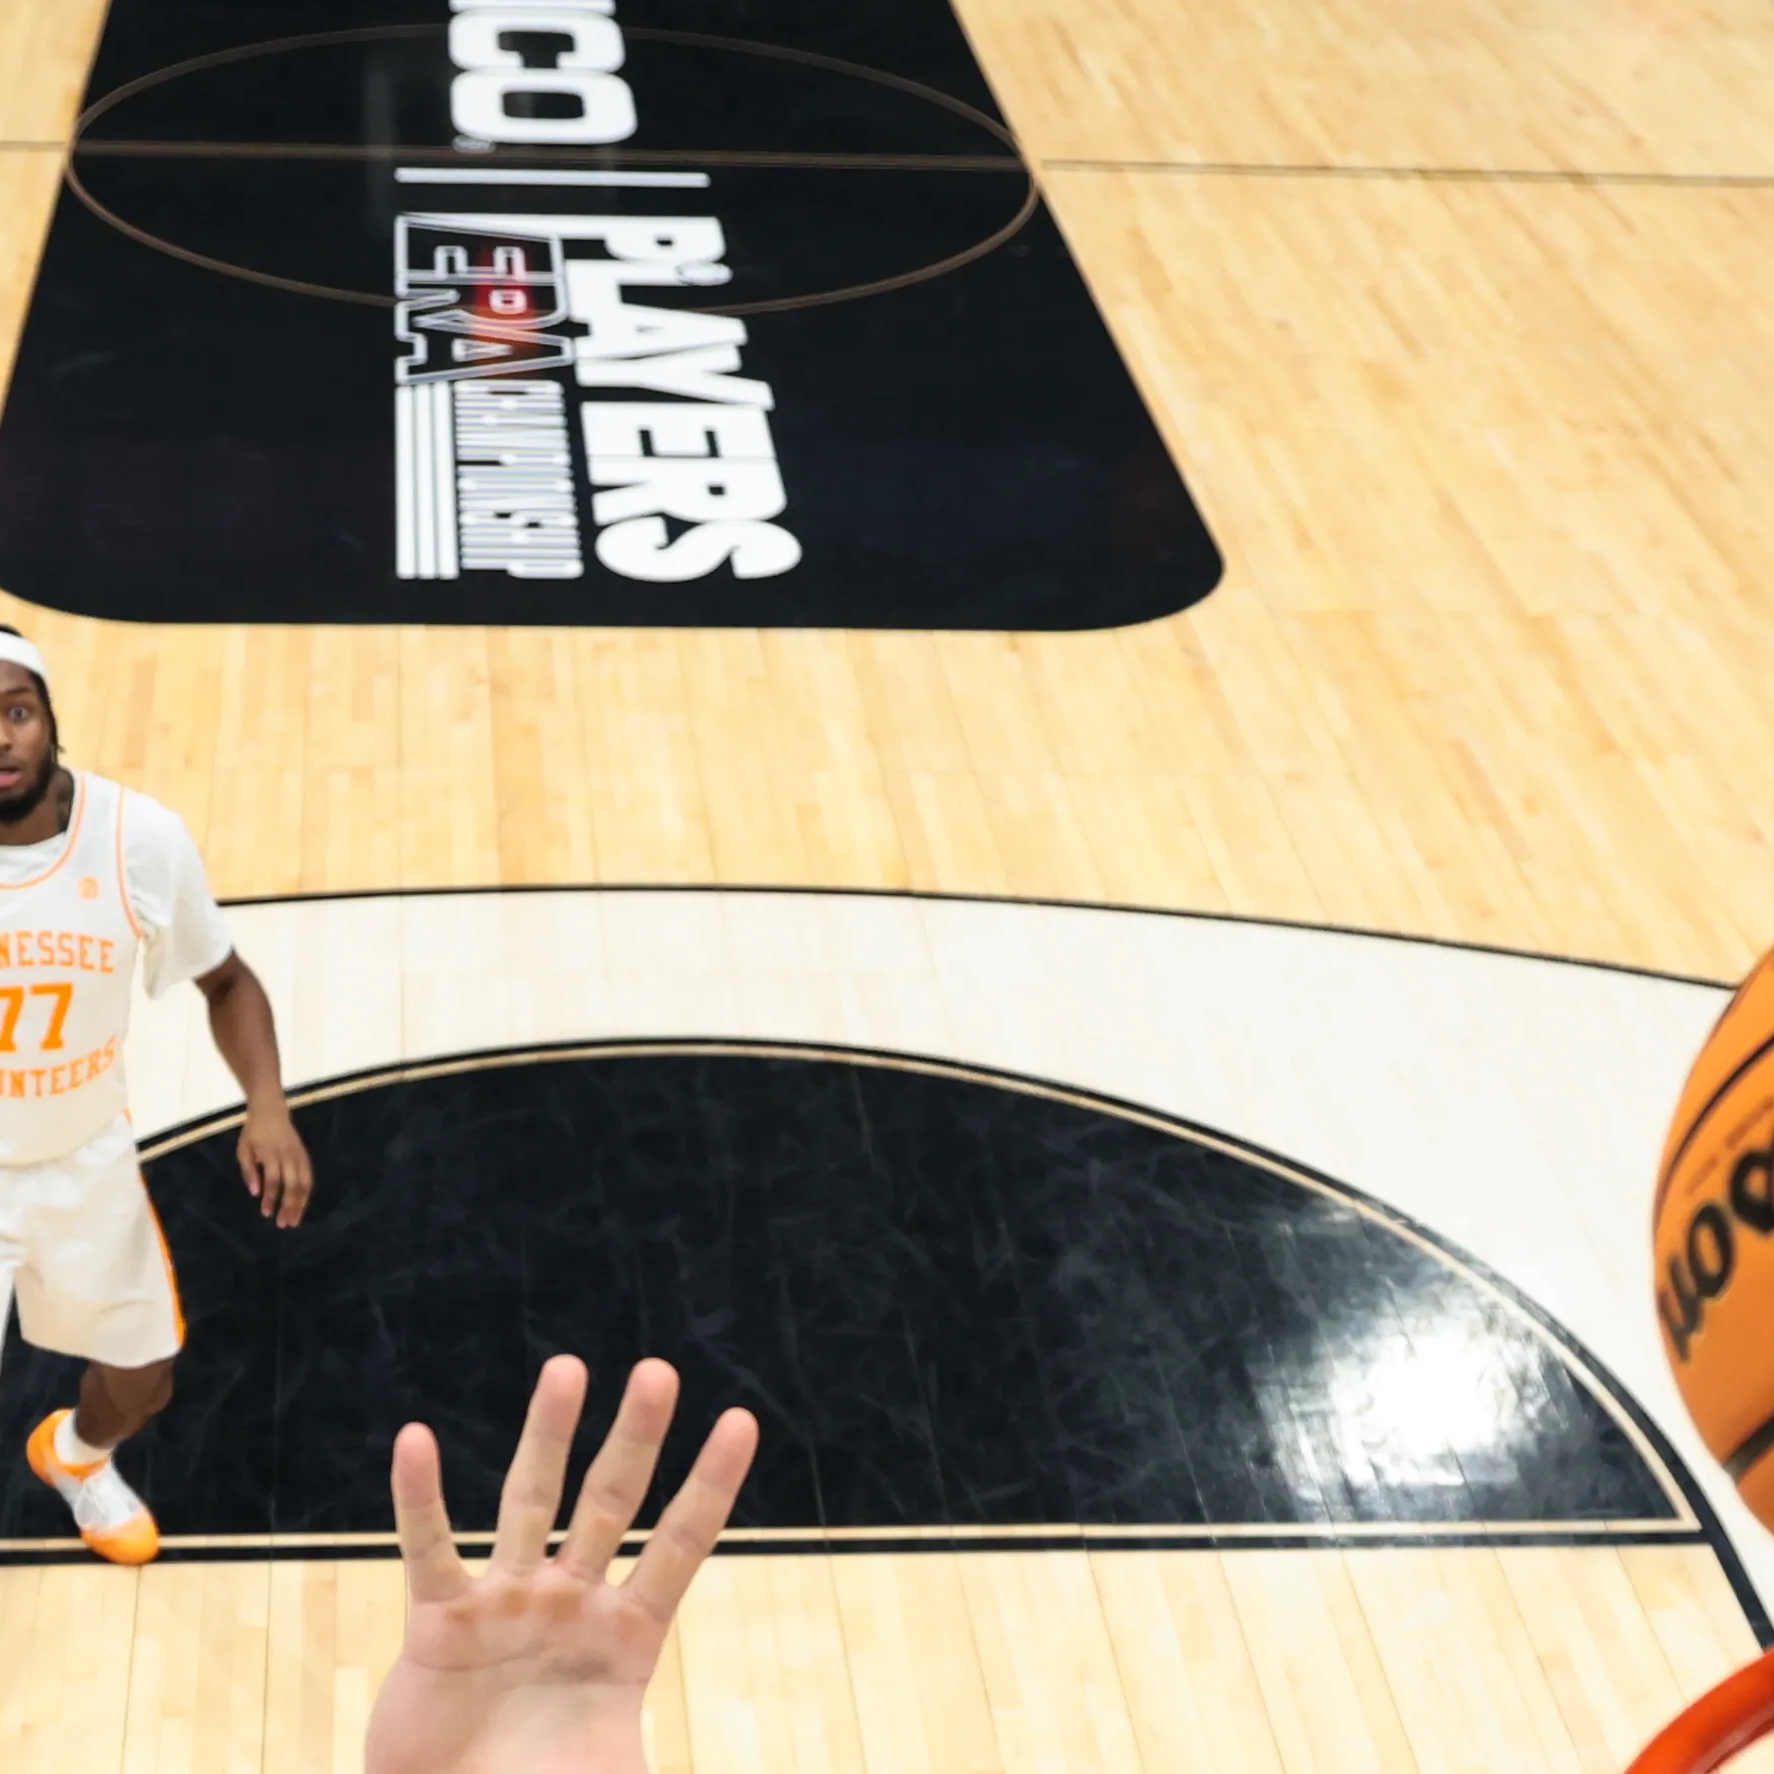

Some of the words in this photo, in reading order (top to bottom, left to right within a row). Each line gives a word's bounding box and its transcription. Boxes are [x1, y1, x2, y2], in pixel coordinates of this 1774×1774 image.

[393, 213, 577, 385] ERA
[397, 214, 803, 582] PLAYERS
[453, 378, 584, 579] CHAMPIONSHIP
